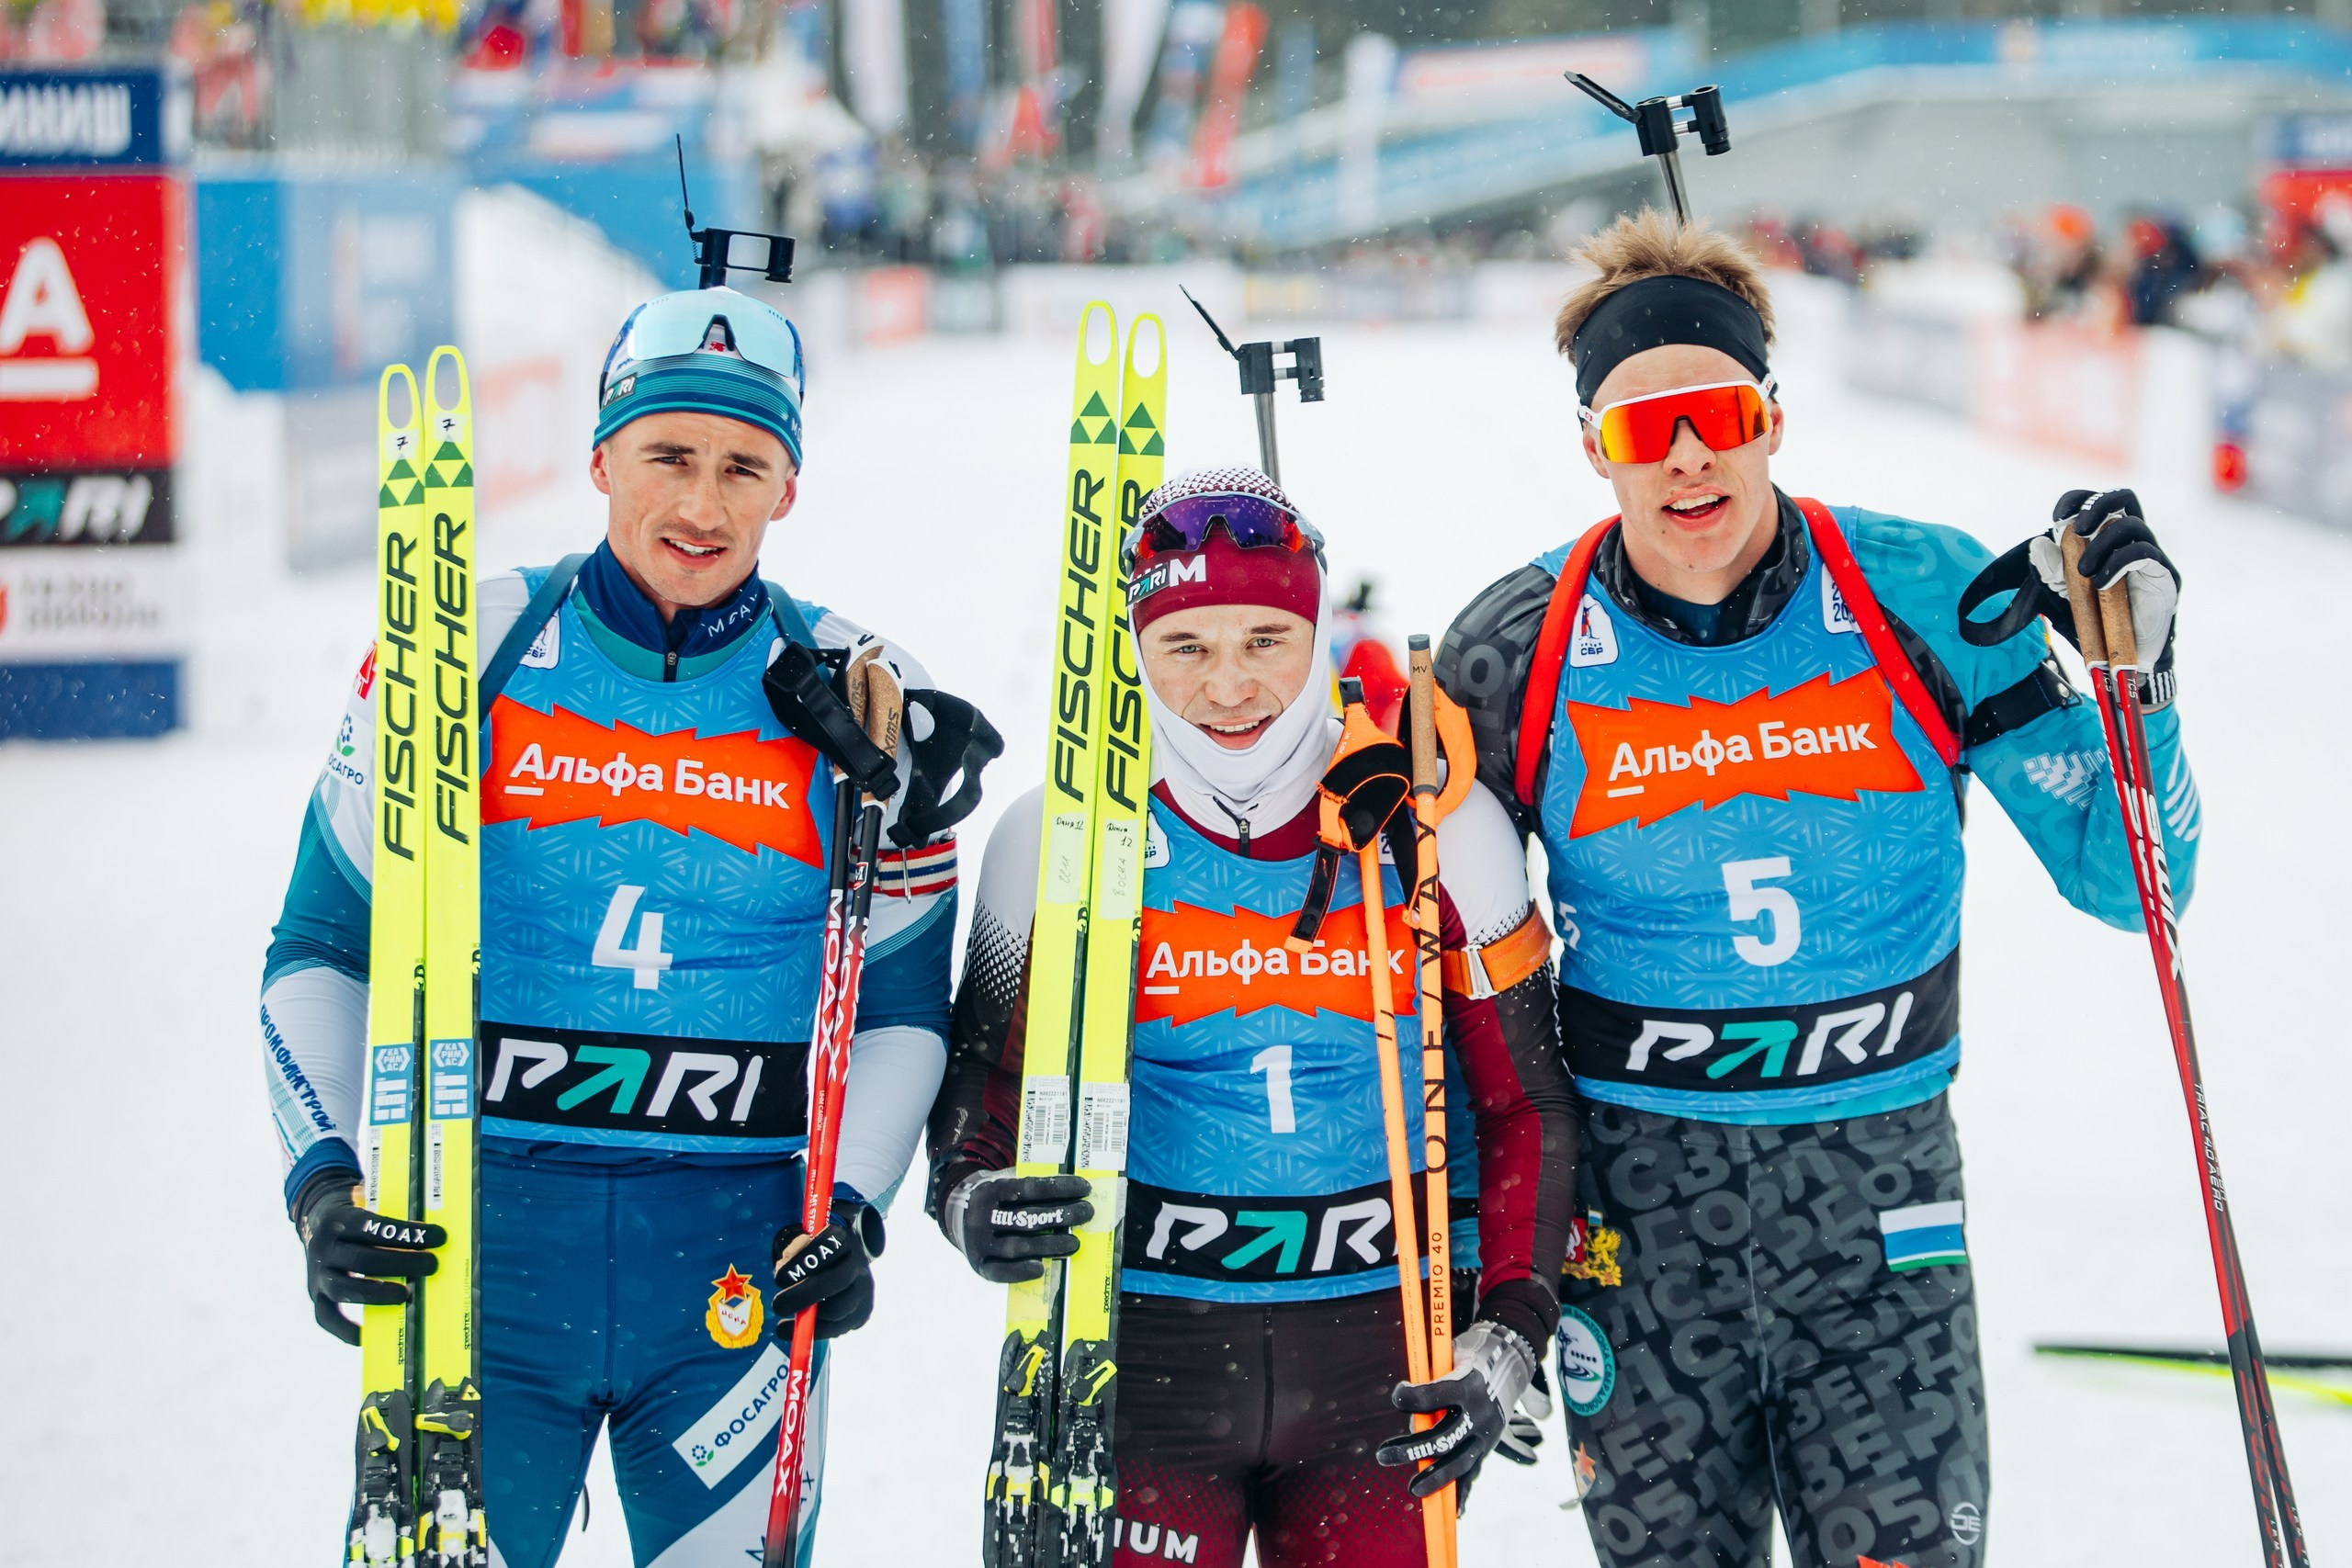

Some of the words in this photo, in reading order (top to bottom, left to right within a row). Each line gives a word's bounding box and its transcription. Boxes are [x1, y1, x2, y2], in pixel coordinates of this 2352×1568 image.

[0, 82, 131, 157] ИНИШ
[1127, 566, 1167, 603] PARI
[1055, 468, 1105, 803] FISCHER
[1106, 479, 1154, 813] FISCR
[1580, 646, 1604, 656] СБР
[384, 532, 417, 862] FISCHER
[434, 513, 469, 846] FISCHER
[328, 753, 364, 785] ОСАГРО
[504, 742, 664, 797] Альфа
[674, 758, 790, 809] Банк
[1608, 729, 1753, 796] Альфа
[1758, 721, 1879, 761] Банк
[592, 884, 673, 990] 4
[1722, 855, 1802, 967] 5
[1145, 939, 1290, 992] Альфа
[1625, 991, 1915, 1080] PARI
[485, 1037, 763, 1122] PARI
[1250, 1044, 1296, 1134] 1
[362, 1219, 426, 1244] MOAX
[788, 1234, 842, 1281] MOAX
[1146, 1197, 1399, 1274] PAR
[1431, 1232, 1442, 1254] 40
[1433, 1264, 1445, 1336] PREMIO
[714, 1363, 789, 1448] ФОСАГРО
[776, 1370, 803, 1498] MOAX
[1114, 1517, 1199, 1565] IUM
